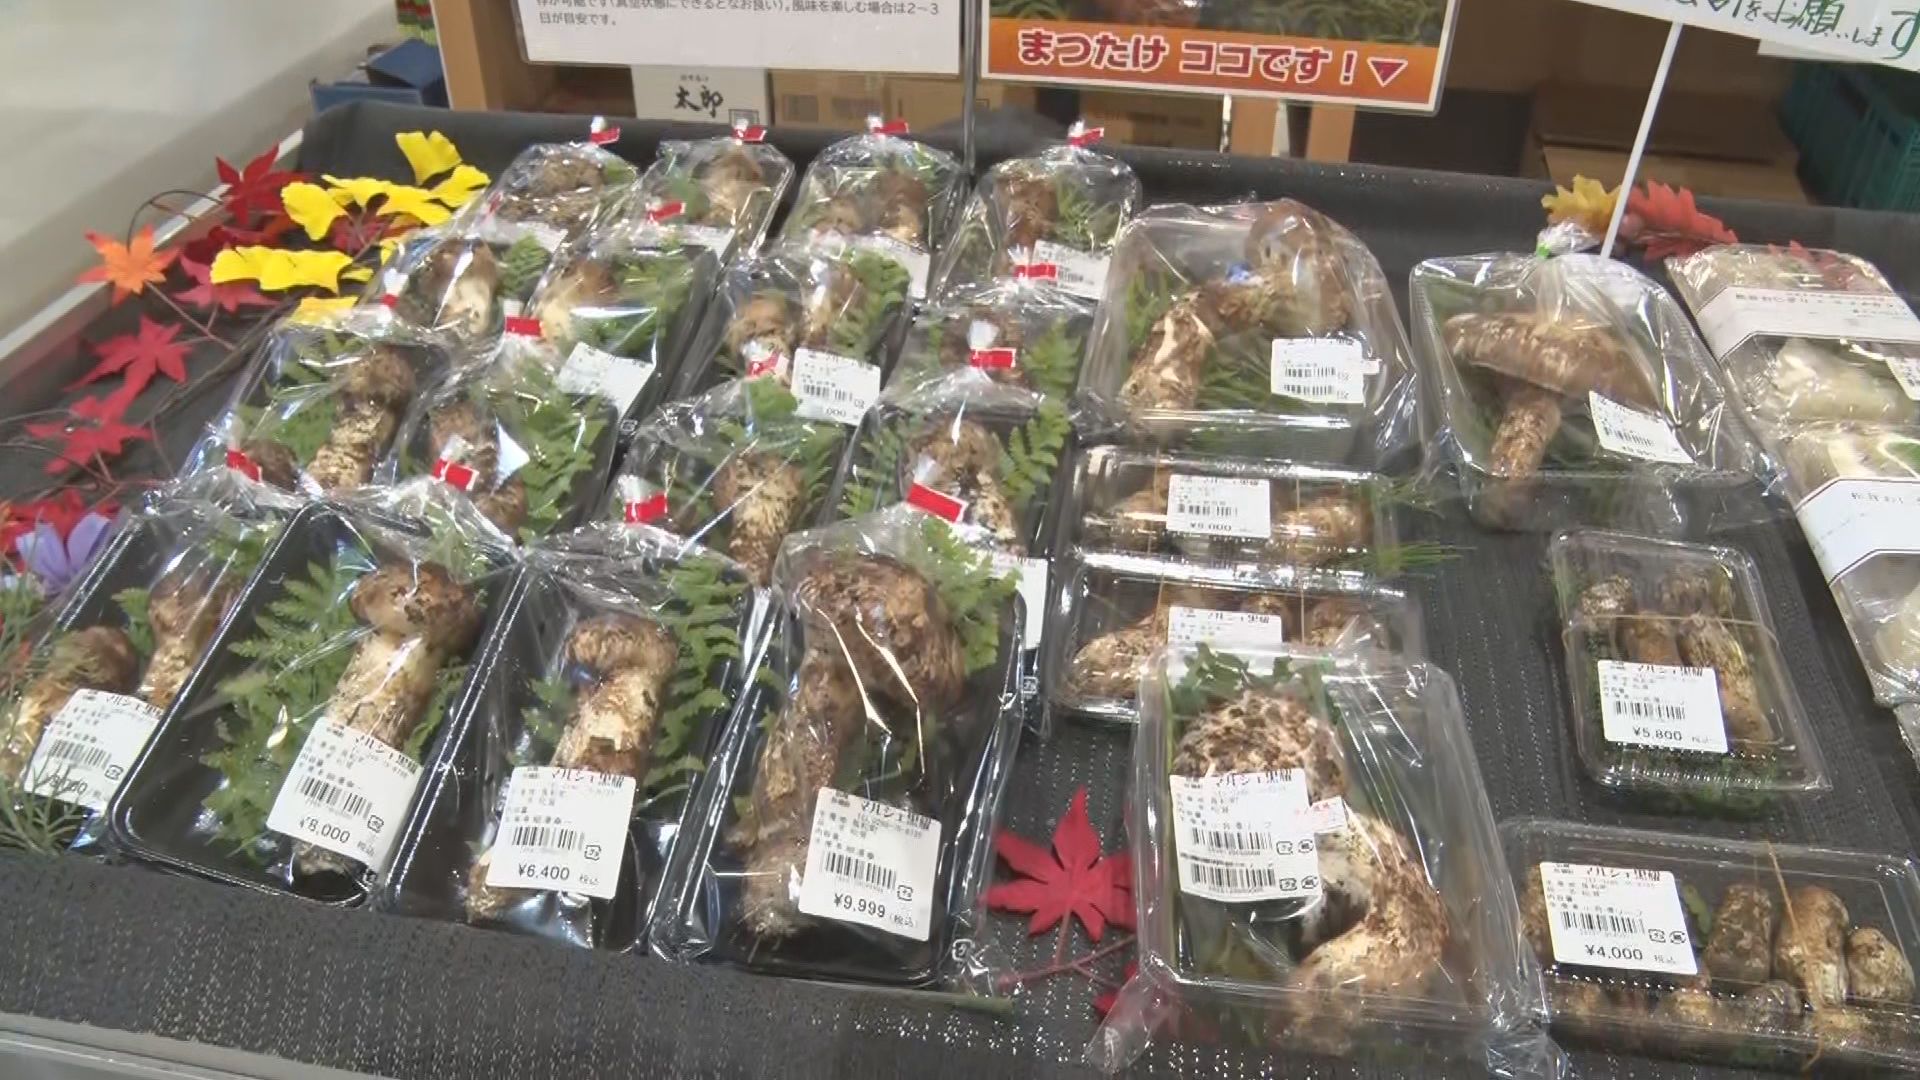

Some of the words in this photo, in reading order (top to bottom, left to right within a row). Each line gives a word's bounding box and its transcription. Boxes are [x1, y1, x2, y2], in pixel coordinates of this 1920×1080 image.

[1017, 29, 1168, 73] まつたけ
[517, 863, 570, 881] ¥6,400
[833, 893, 886, 918] ¥9,999
[1585, 944, 1643, 961] ¥4,000
